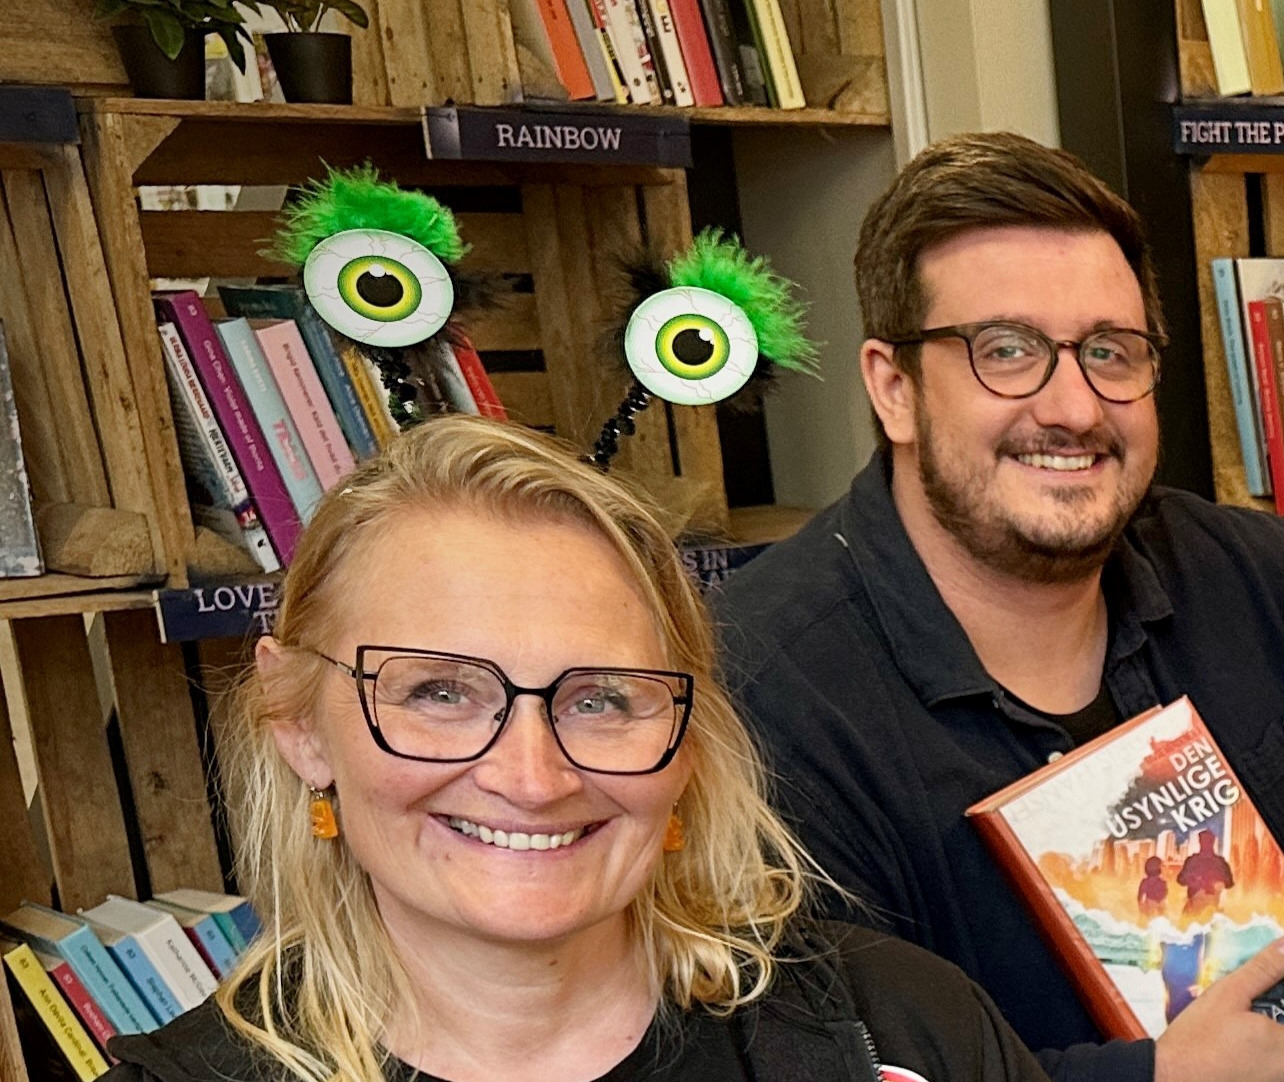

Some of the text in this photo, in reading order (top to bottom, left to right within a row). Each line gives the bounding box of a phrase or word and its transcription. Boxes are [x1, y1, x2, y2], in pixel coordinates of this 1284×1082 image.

[496, 123, 622, 150] RAINBOW
[1180, 121, 1232, 143] FIGHT
[1235, 121, 1271, 144] THE
[194, 584, 279, 612] LOVE
[1171, 737, 1214, 773] DEN
[1106, 756, 1227, 839] USYNLIGE
[1170, 779, 1241, 834] KRIG
[18, 957, 30, 969] 83
